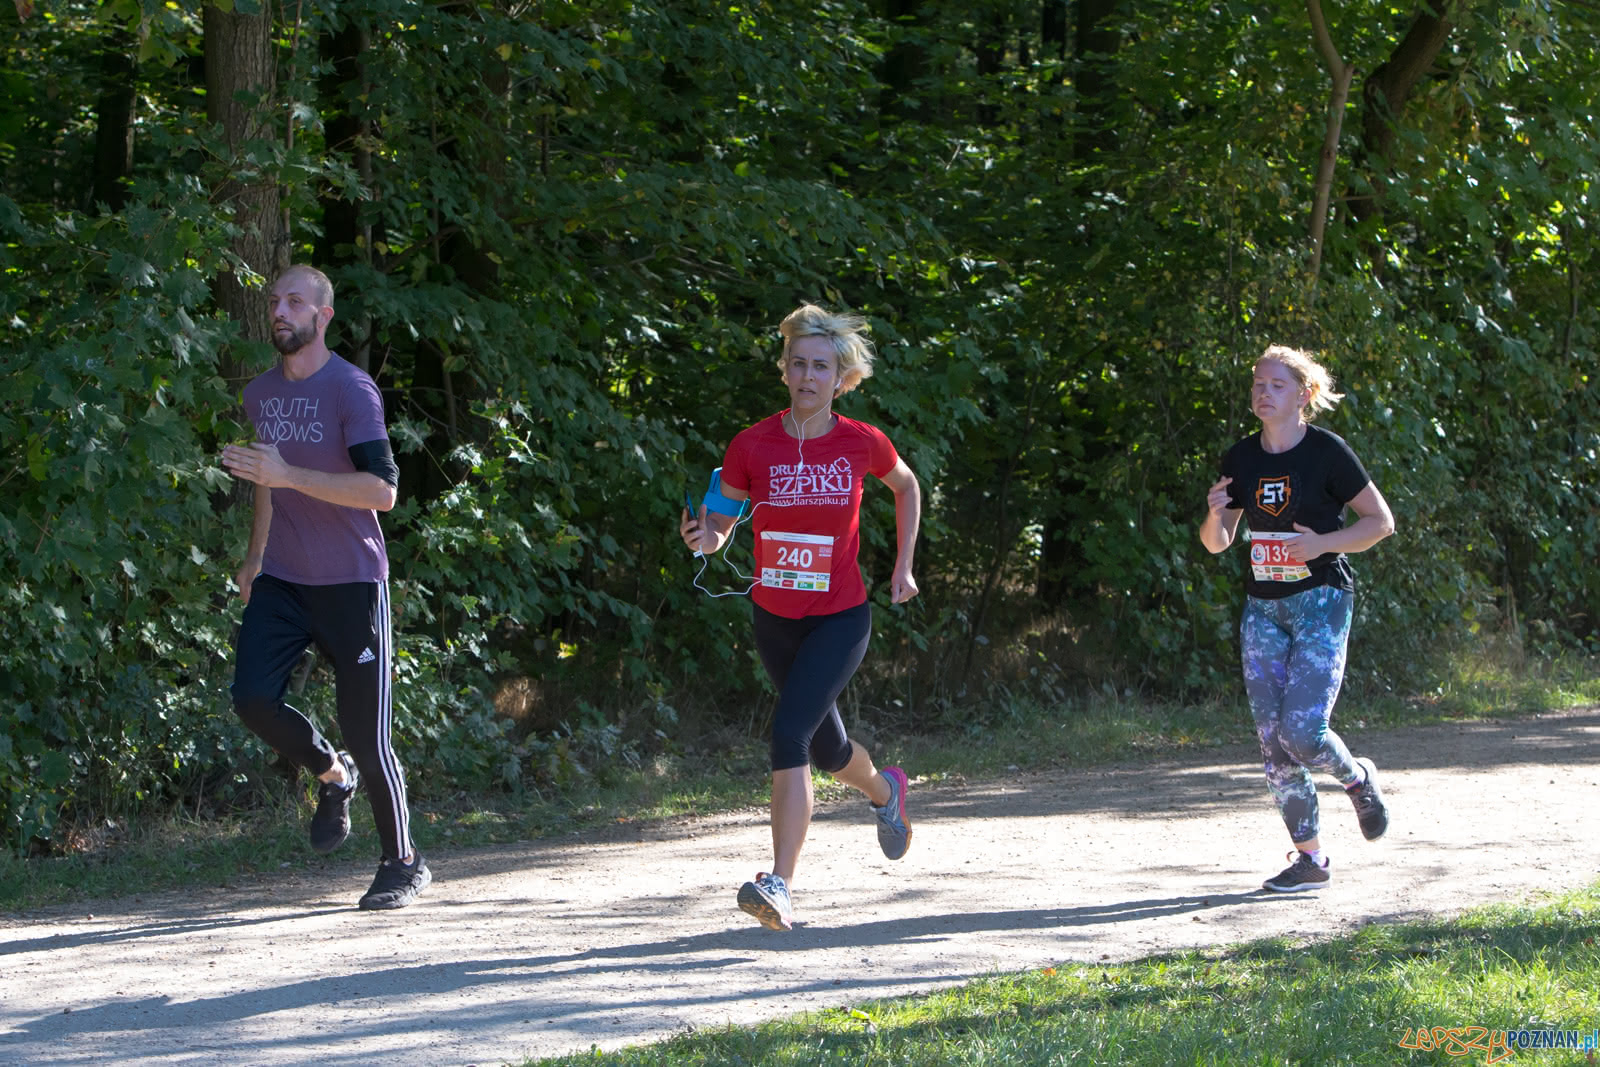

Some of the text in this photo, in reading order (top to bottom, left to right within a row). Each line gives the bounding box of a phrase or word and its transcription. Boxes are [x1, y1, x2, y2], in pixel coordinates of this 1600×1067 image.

[260, 397, 320, 418] YOUTH
[255, 421, 323, 443] KNOWS
[769, 474, 852, 496] SZPIKU
[777, 547, 812, 568] 240
[1265, 545, 1289, 562] 139
[357, 655, 376, 664] adidas
